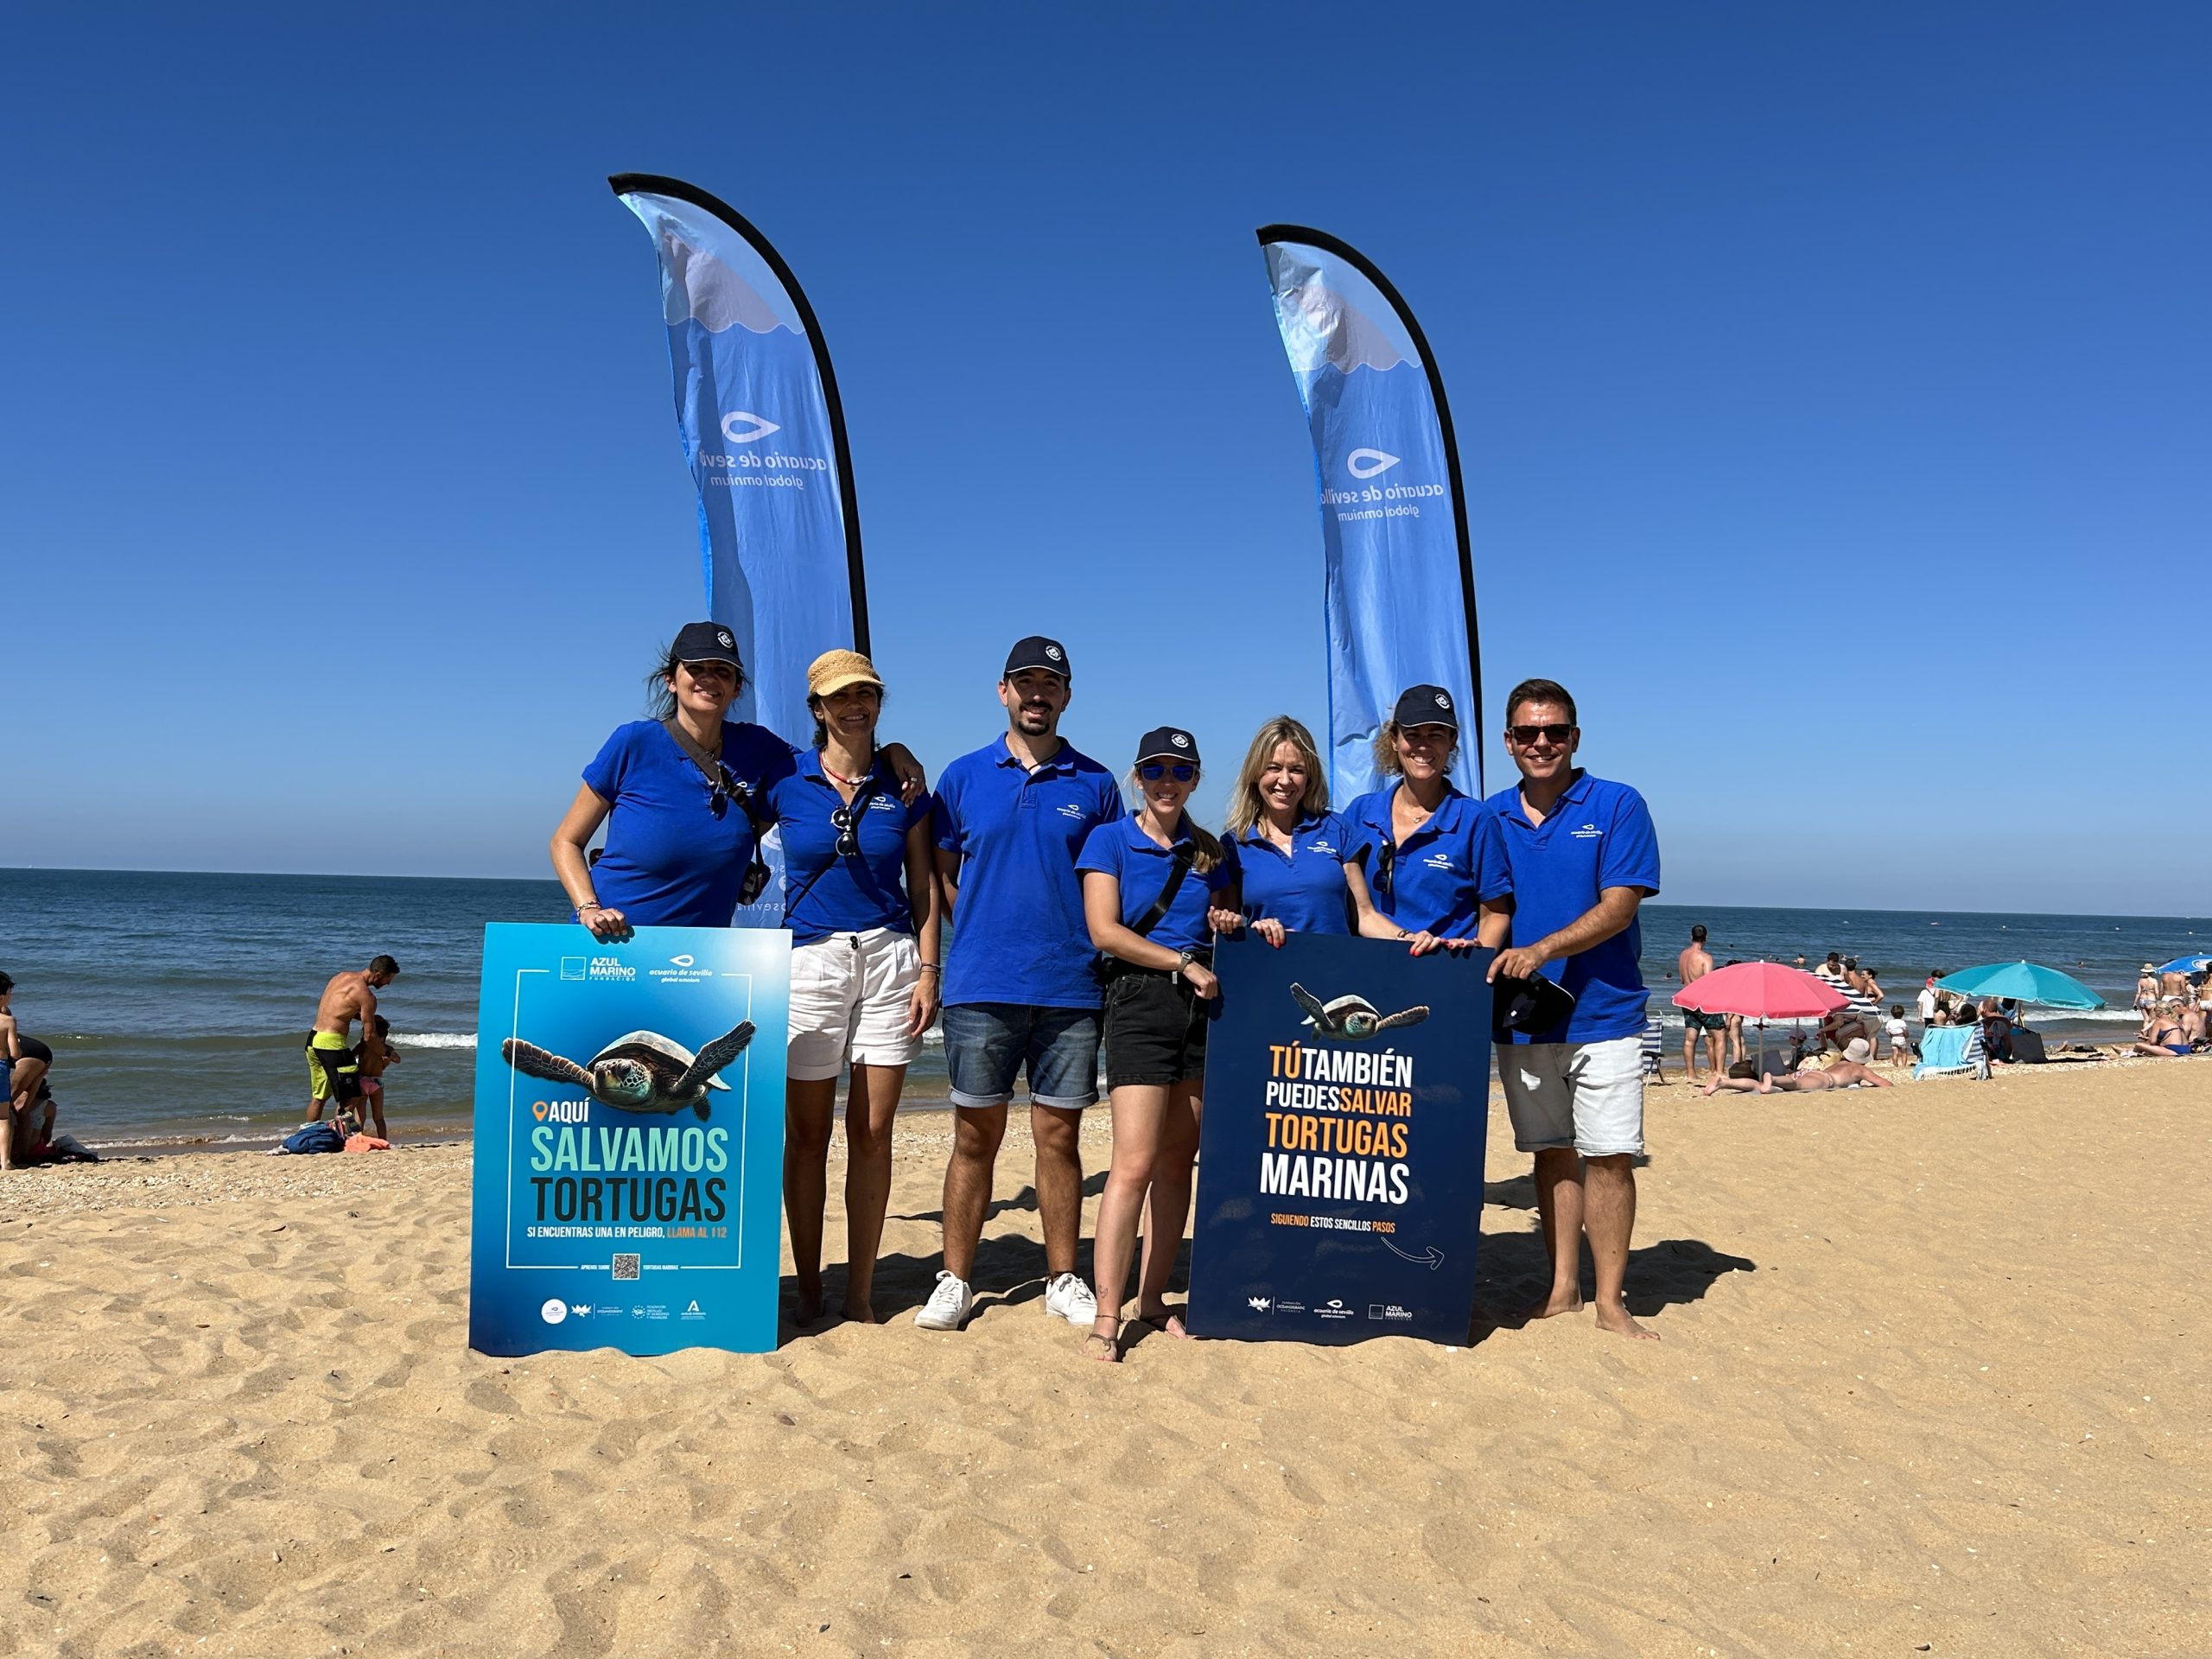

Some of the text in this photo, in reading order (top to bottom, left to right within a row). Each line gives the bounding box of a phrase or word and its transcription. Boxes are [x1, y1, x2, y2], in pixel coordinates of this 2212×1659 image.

[589, 967, 636, 976] MARINO
[591, 957, 620, 967] AZUL
[548, 1096, 590, 1123] AQUÍ
[1265, 1112, 1408, 1159] TORTUGAS
[531, 1126, 728, 1173] SALVAMOS
[1260, 1152, 1410, 1205] MARINAS
[530, 1176, 728, 1223] TORTUGAS
[526, 1226, 728, 1239] SI ENCUENTRAS UNA EN PELIGRO, LLAMA AL 112
[1270, 1212, 1396, 1234] SIGUIENDO ESTOS SENCILLOS PASOS
